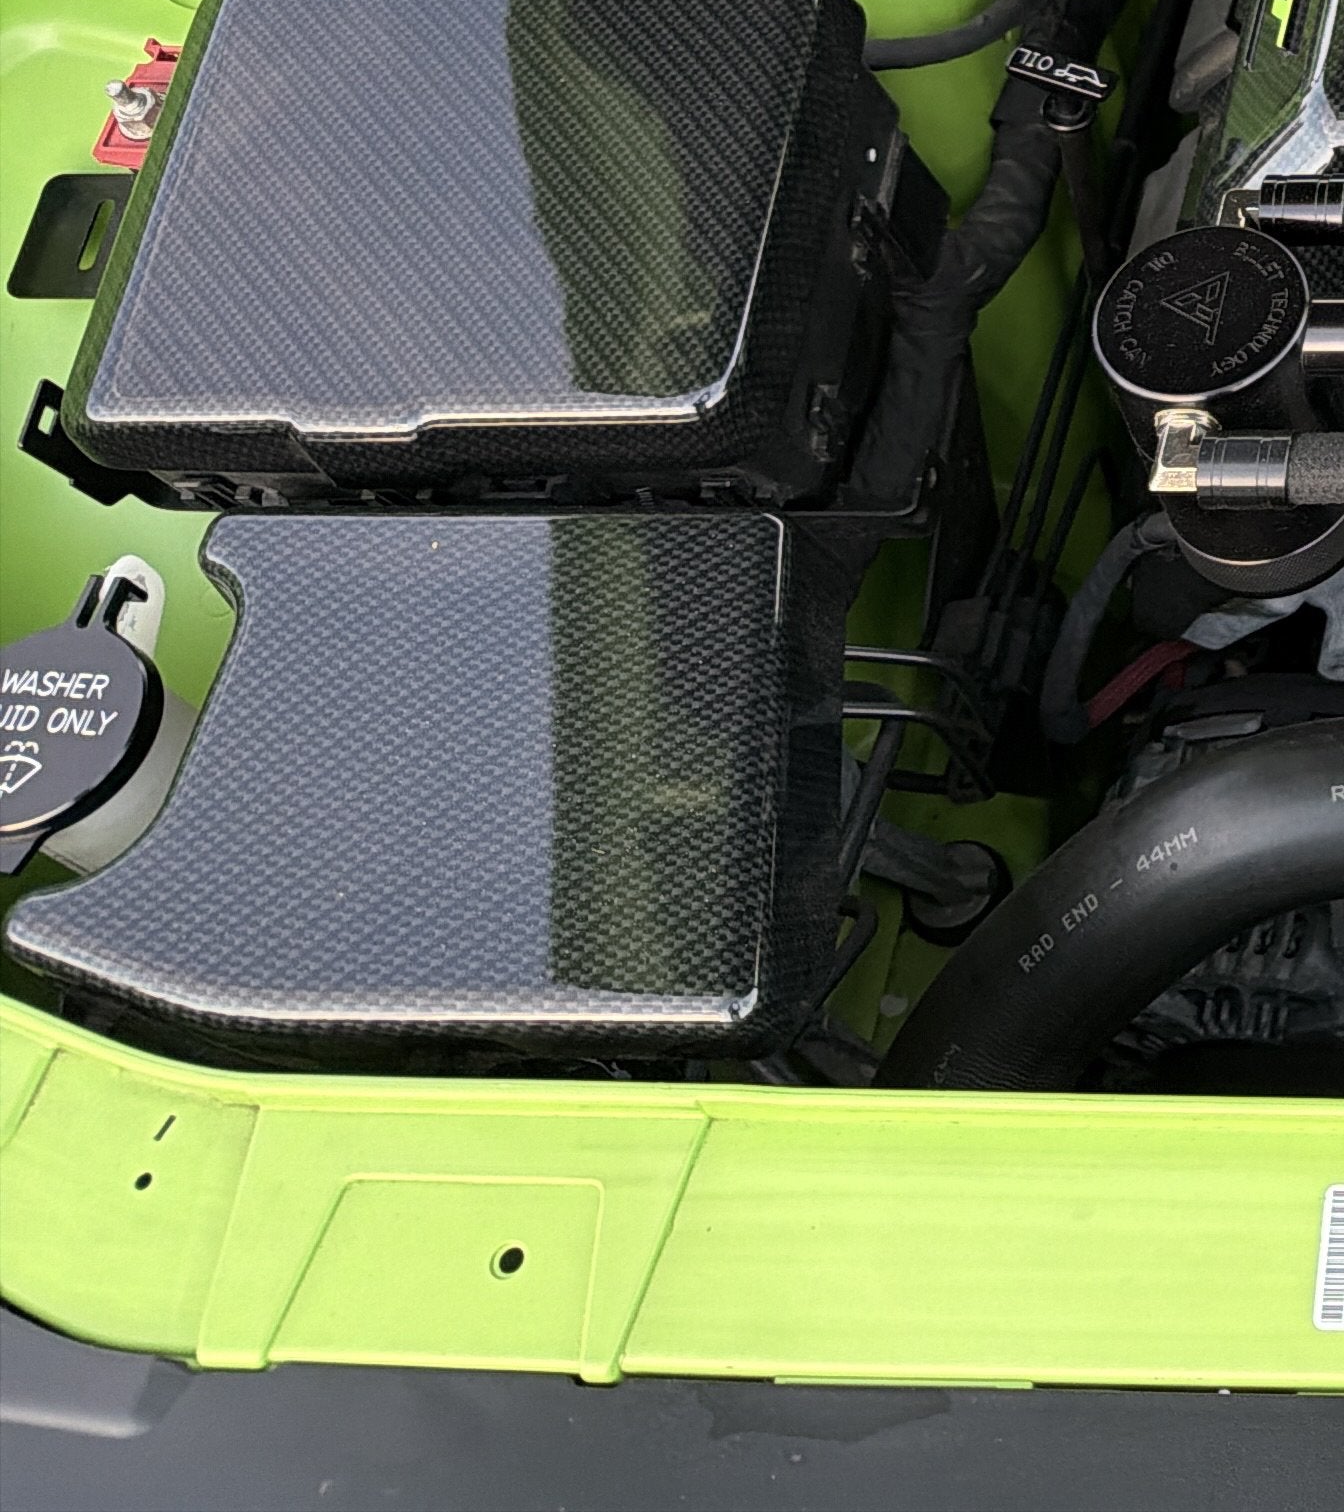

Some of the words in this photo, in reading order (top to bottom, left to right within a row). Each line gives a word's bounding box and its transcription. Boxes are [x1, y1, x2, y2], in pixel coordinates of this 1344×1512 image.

[1018, 48, 1054, 71] OIL
[1141, 251, 1179, 273] OIL
[1113, 279, 1144, 333] CATCH
[1210, 288, 1289, 377] TECHNOLOGY
[2, 668, 110, 700] WASHER
[47, 707, 118, 736] ONLY
[1018, 932, 1056, 974] RAD
[1061, 892, 1100, 932] END
[1135, 826, 1198, 872] 44MM
